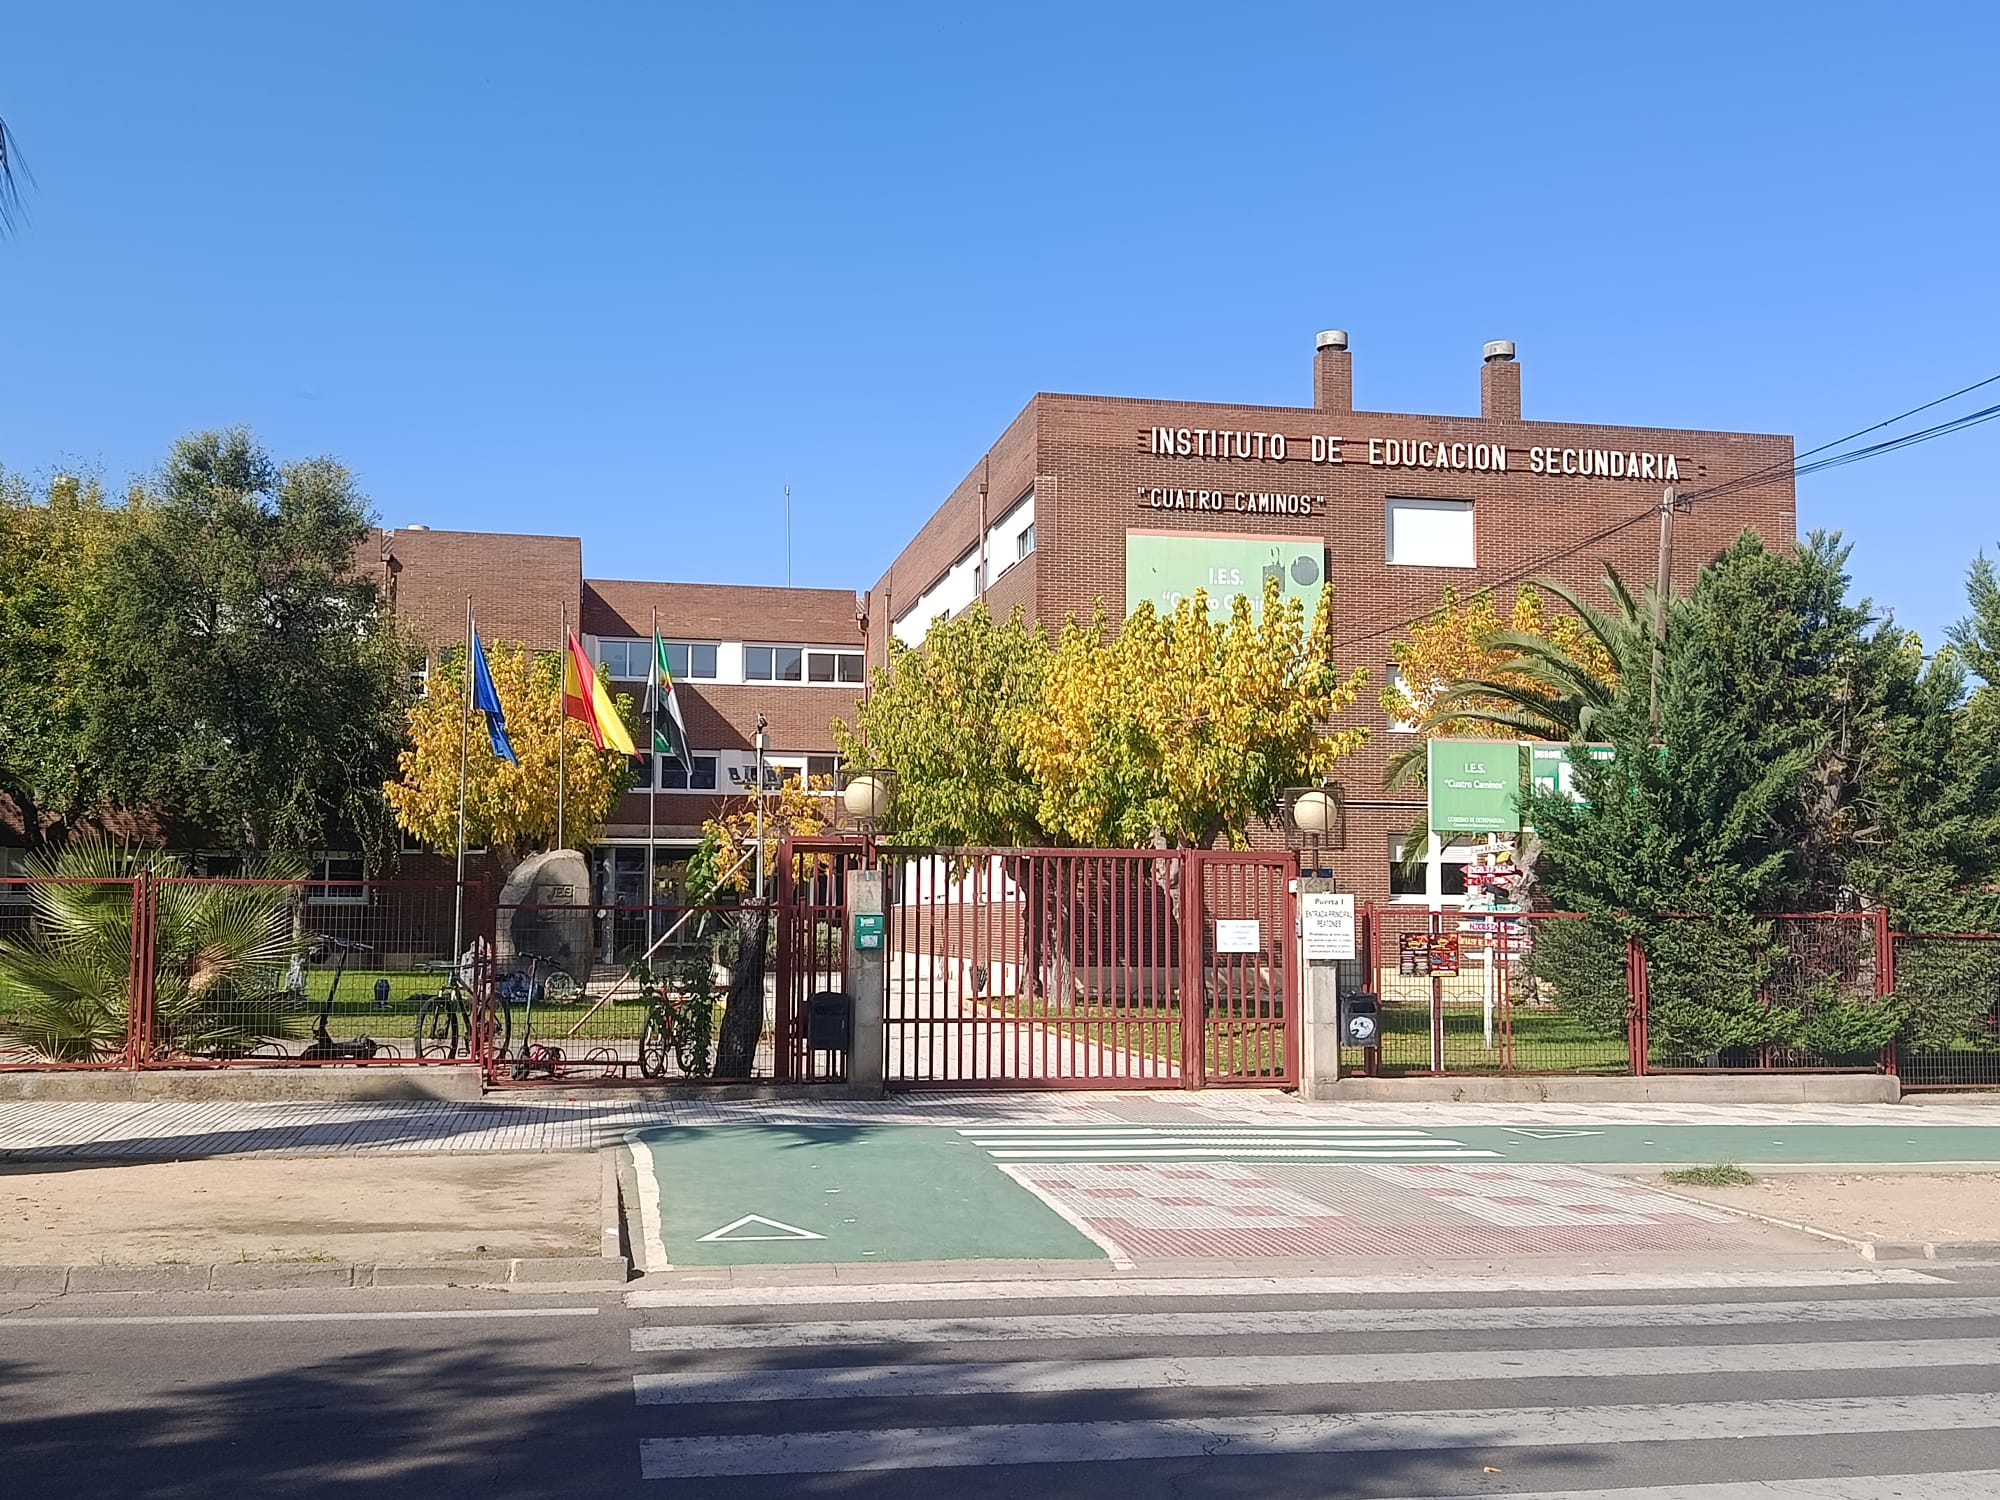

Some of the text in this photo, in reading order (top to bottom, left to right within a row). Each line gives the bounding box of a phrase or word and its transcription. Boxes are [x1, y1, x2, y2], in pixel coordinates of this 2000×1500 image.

[1151, 426, 1679, 480] INSTITUTO DE EDUCACION SECUNDARIA
[1208, 567, 1244, 585] I.E.S.
[1464, 763, 1486, 774] I.E.S.
